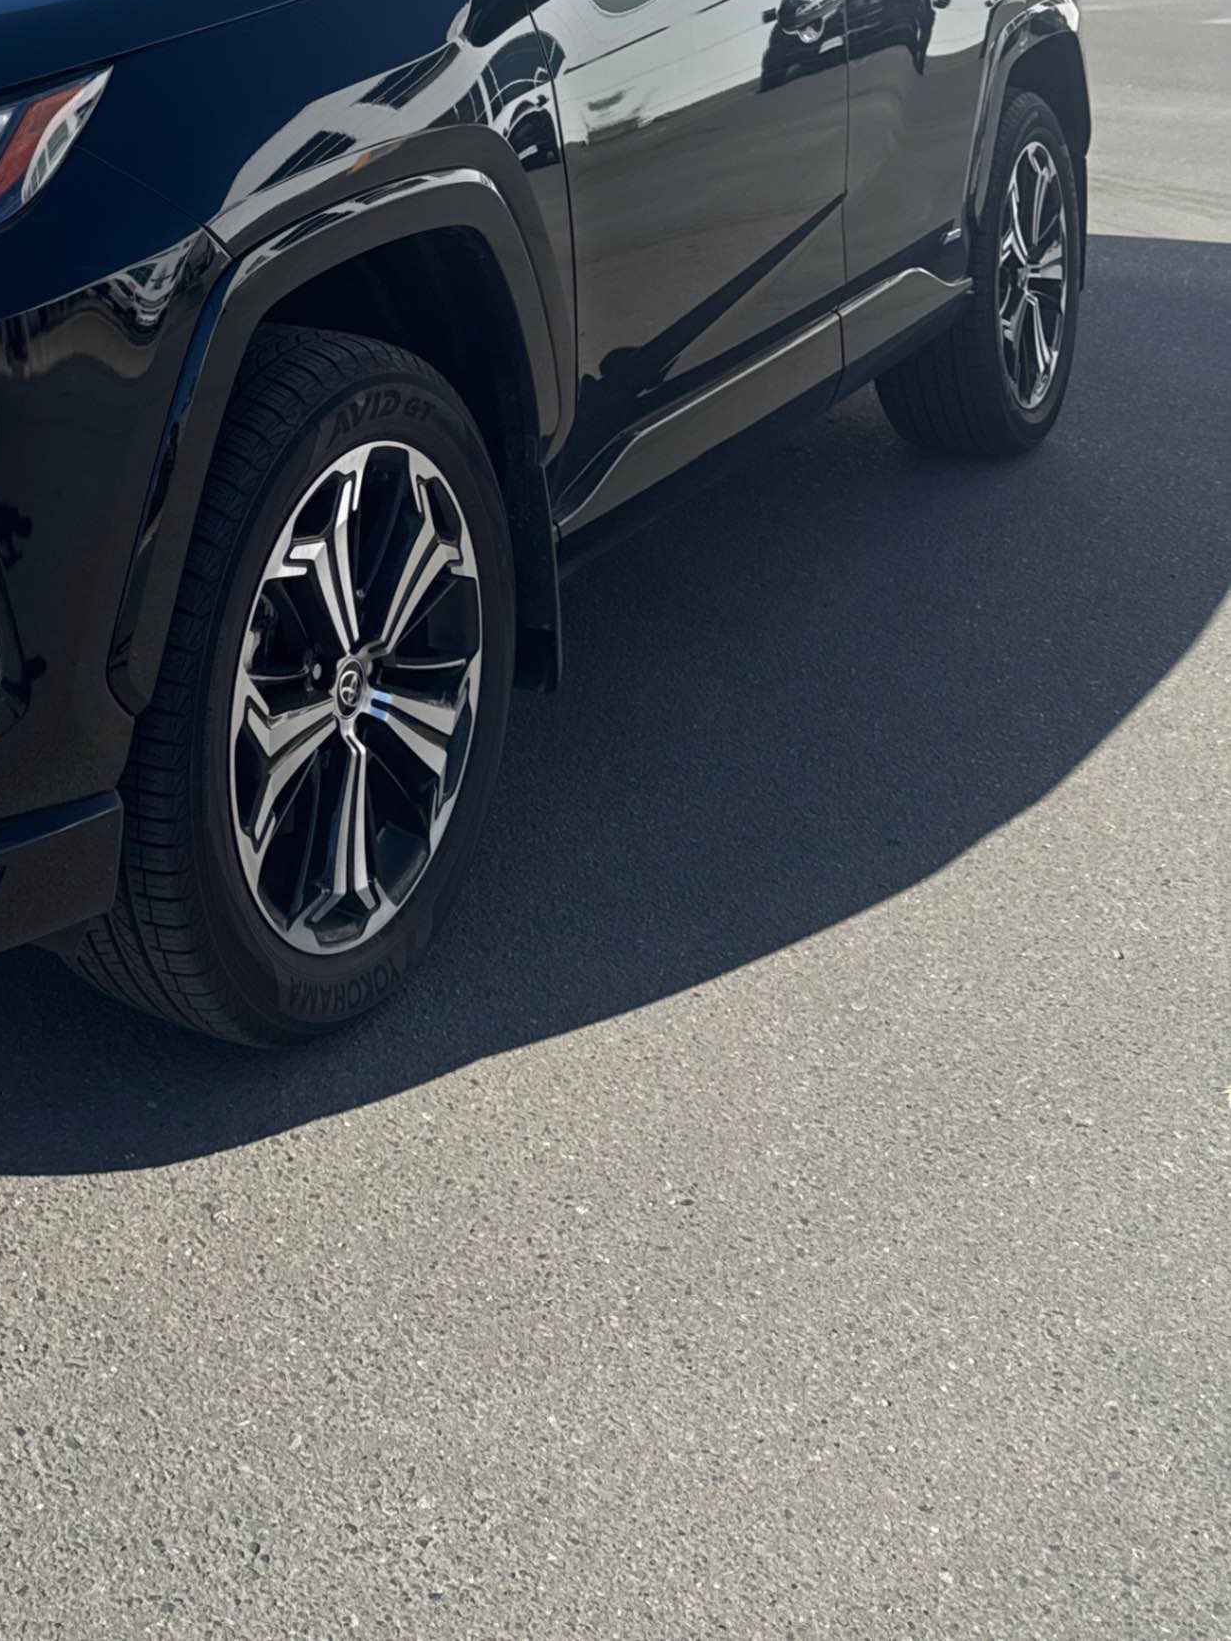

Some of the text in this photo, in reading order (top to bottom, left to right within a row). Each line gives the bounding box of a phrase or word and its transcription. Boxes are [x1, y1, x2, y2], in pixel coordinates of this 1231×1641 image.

[327, 390, 435, 442] AVID GT
[289, 961, 401, 1015] YOKOHAMA
